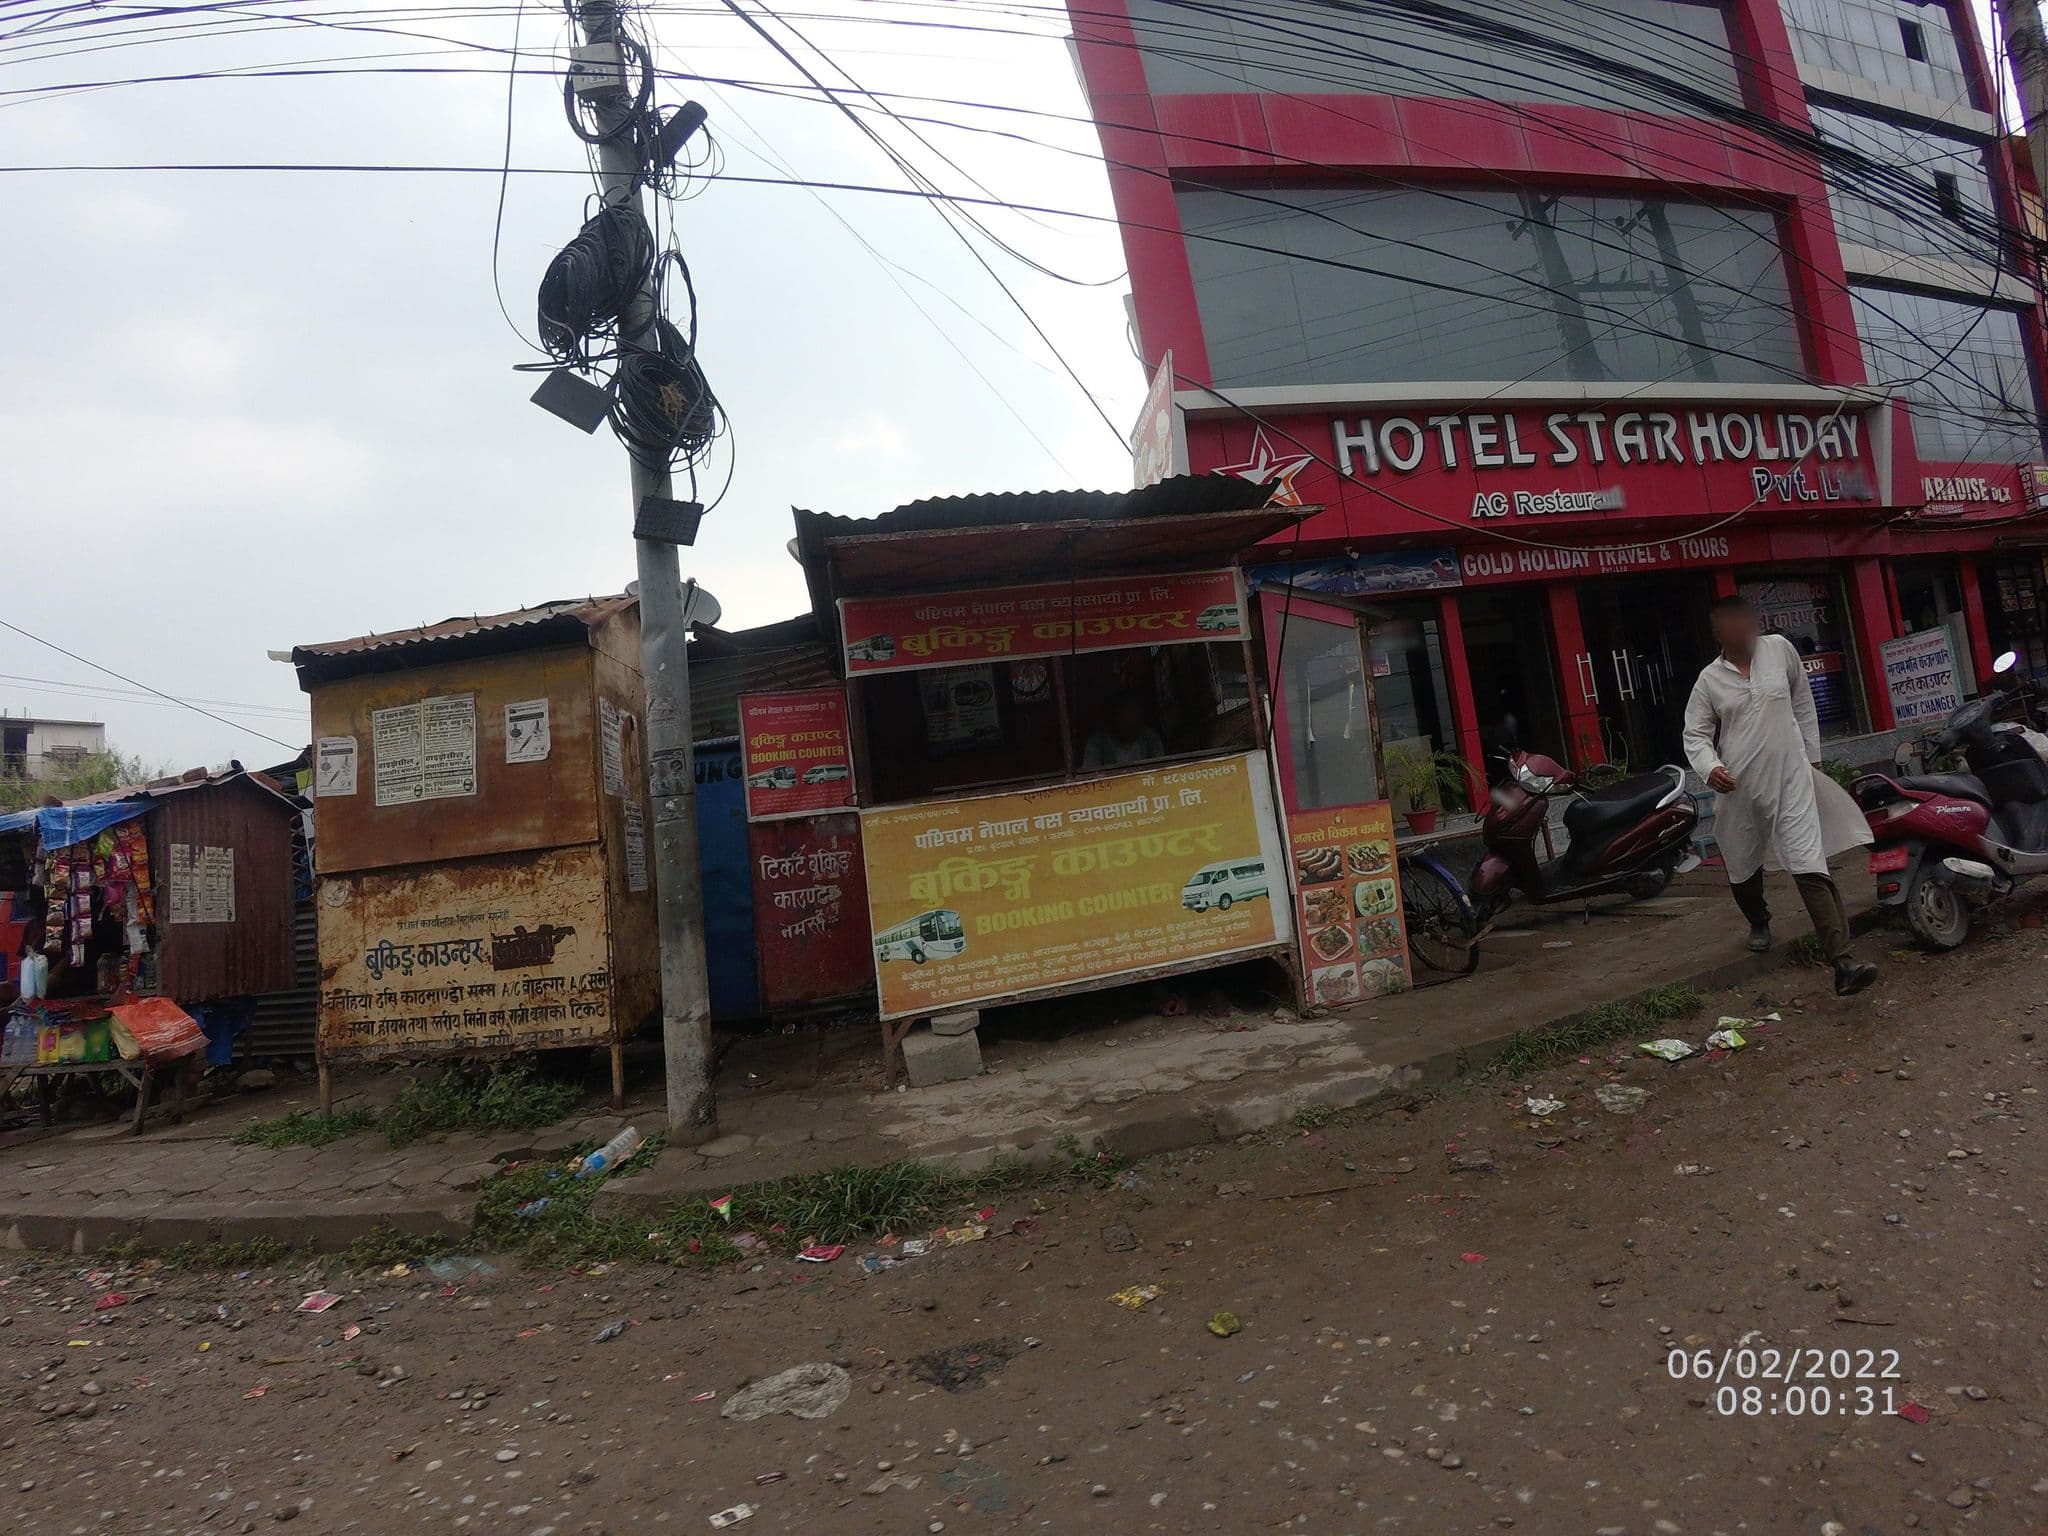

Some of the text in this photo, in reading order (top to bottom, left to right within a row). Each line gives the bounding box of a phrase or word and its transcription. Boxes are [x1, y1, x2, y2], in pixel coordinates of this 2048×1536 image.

[1332, 410, 1860, 477] HOTEL STAR HOLIDAY
[1752, 465, 1818, 503] Pvt.
[1921, 477, 1989, 502] ARADISE
[1472, 491, 1509, 519] AC
[1464, 536, 1729, 577] GOLD HOLIDAY TRAVEL & TOURS
[972, 600, 1016, 616] नेपाल
[1020, 598, 1046, 611] बस
[1032, 608, 1192, 641] काउण्टर
[1915, 670, 1954, 690] काउण्टर
[1895, 701, 1918, 720] MONEY
[1919, 694, 1960, 714] CHANGER
[791, 729, 843, 742] काउण्टर
[751, 745, 845, 764] BOOKING COUNTER
[914, 826, 974, 849] पश्चिम
[978, 817, 1030, 840] नेपाल
[1033, 811, 1064, 831] बस
[1067, 794, 1148, 823] व्यवसायी
[1152, 795, 1175, 815] प्रा.
[1178, 788, 1208, 808] लि.
[1936, 804, 1972, 816] Pleasure
[1294, 829, 1325, 844] नमस्ते
[1328, 826, 1358, 839] चिकन
[1051, 823, 1225, 877] काउण्टर
[976, 881, 1174, 936] BOOKING COUNTER
[417, 938, 486, 968] काउन्टर
[502, 980, 520, 997] A/C
[408, 1016, 428, 1033] तथा
